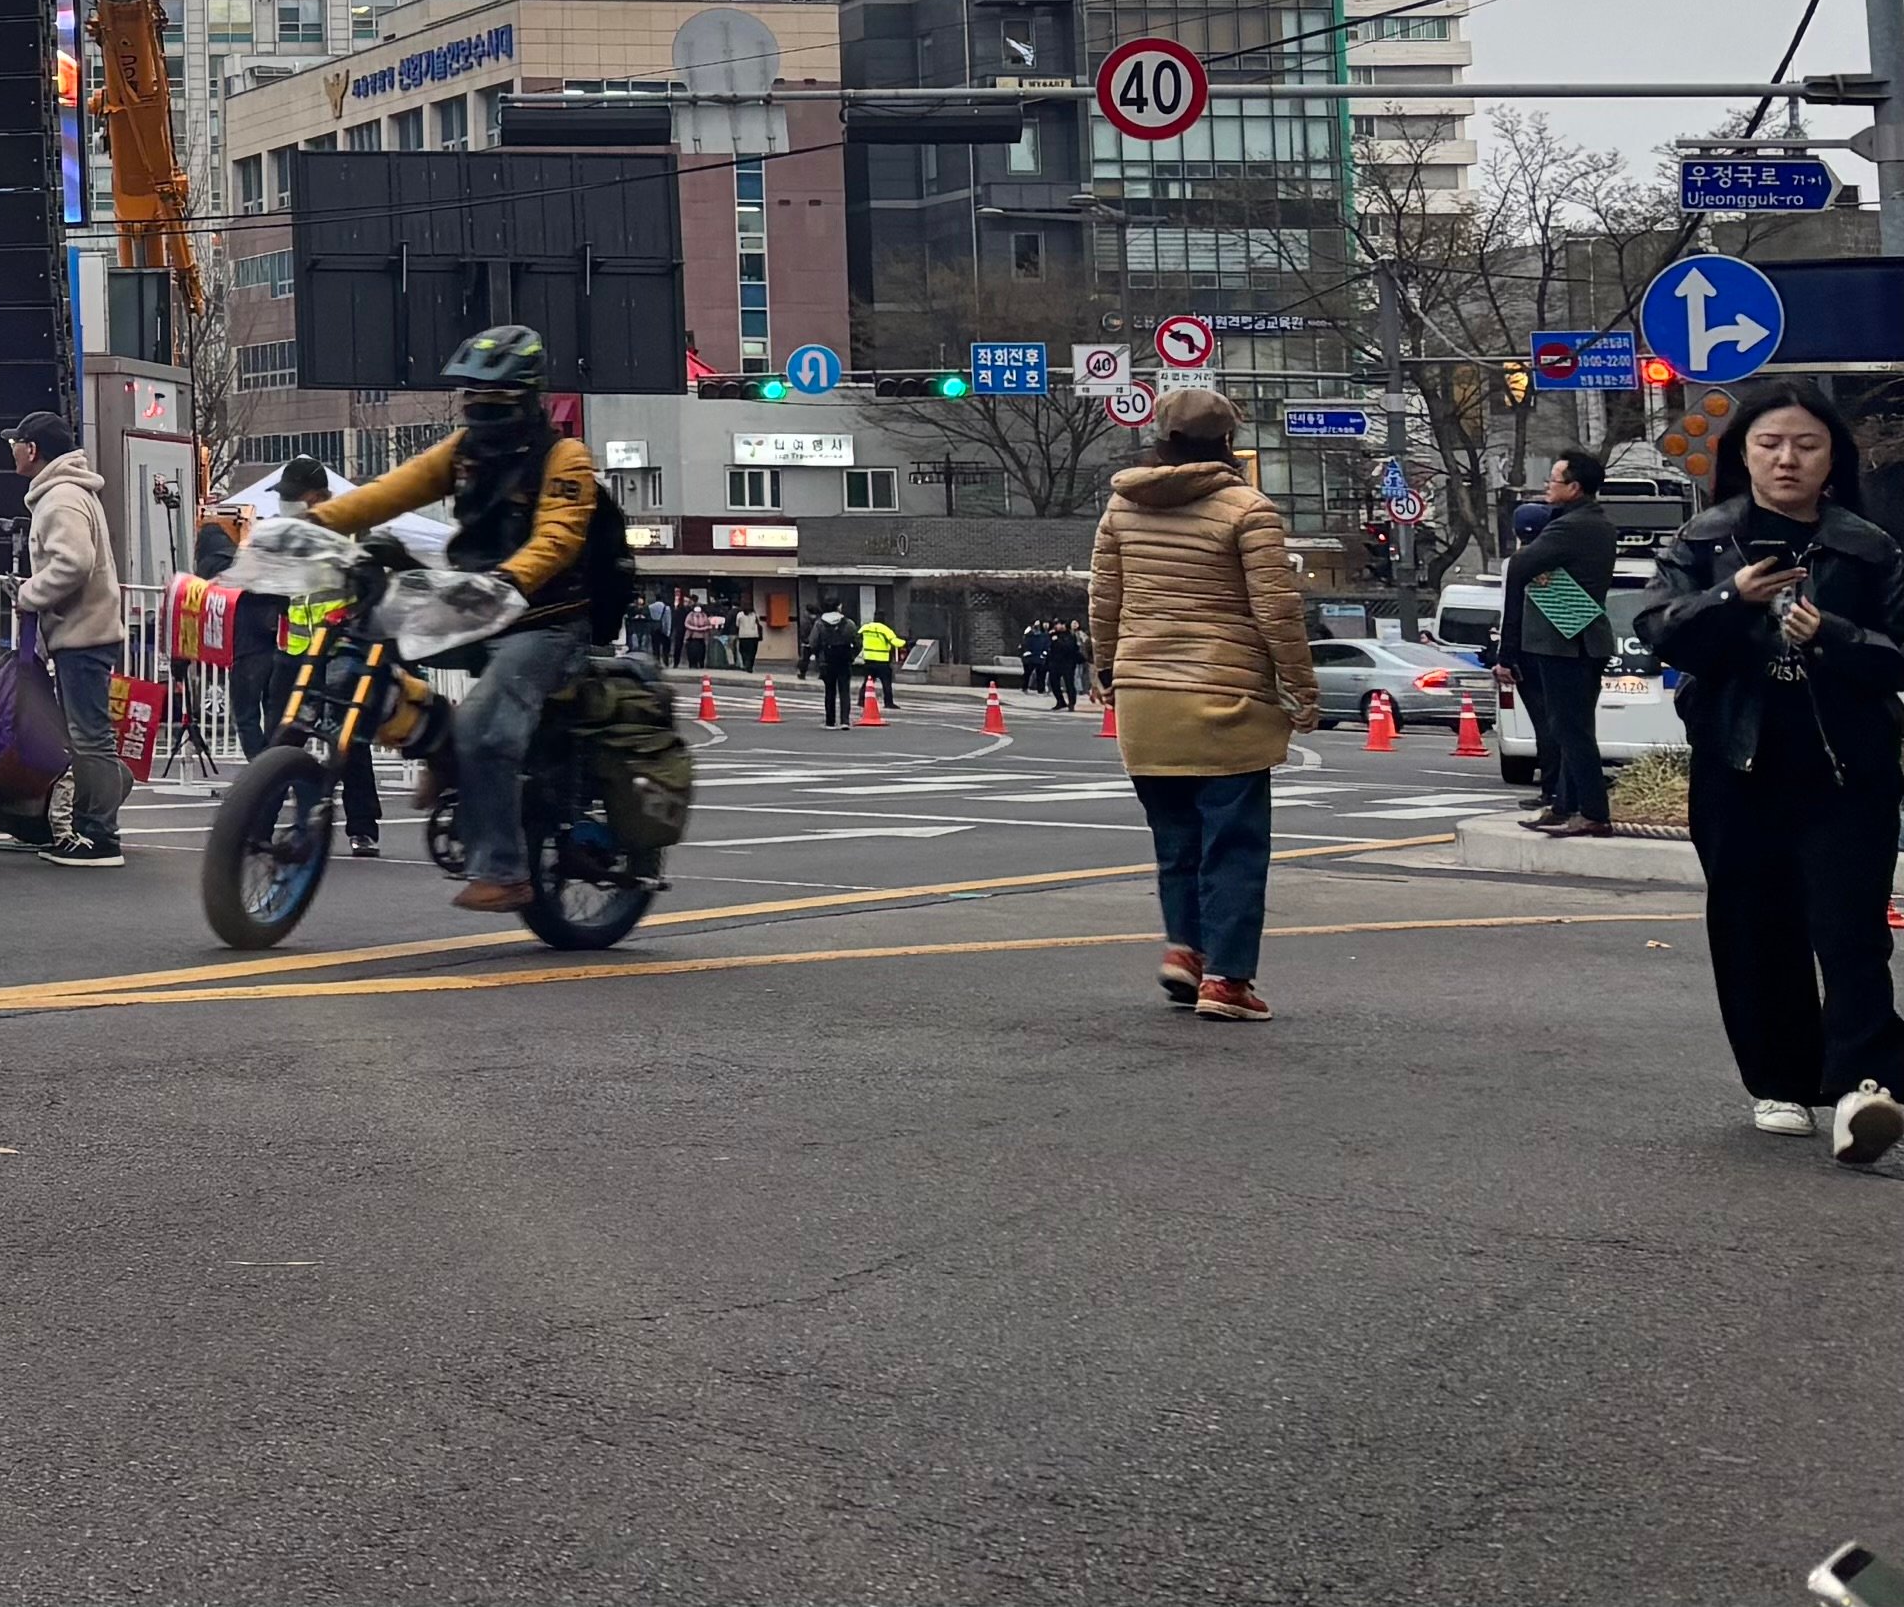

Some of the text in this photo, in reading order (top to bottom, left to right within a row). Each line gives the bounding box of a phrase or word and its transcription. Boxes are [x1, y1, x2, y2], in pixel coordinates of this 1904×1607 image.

[1119, 60, 1183, 115] 40
[1687, 165, 1781, 188] 우정국로
[1687, 191, 1804, 208] Ujeongguk-ro
[977, 348, 1040, 367] 좌회전후
[1093, 359, 1111, 373] 40
[1116, 396, 1147, 414] 50
[1395, 498, 1417, 515] 50
